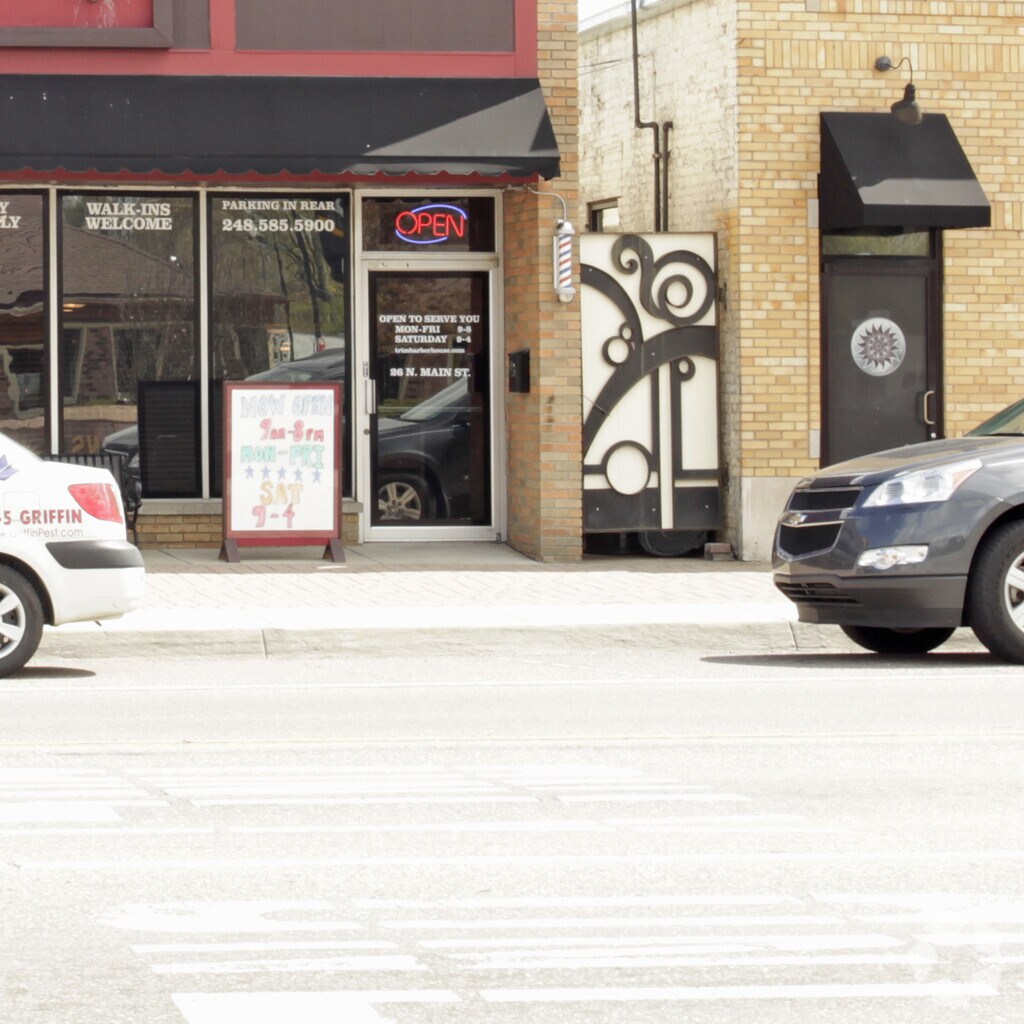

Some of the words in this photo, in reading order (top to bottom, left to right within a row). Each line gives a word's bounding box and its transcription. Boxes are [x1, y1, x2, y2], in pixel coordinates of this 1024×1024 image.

[86, 202, 171, 216] WALK-INS
[222, 200, 280, 211] PARKING
[282, 201, 298, 211] IN
[300, 201, 336, 211] REAR
[85, 217, 173, 231] WELCOME
[222, 219, 335, 232] 248.585.5900
[395, 211, 465, 237] OPEN
[379, 315, 407, 323] OPEN
[408, 315, 423, 323] TO
[424, 315, 457, 323] SERVE
[459, 315, 480, 323] YOU
[395, 325, 441, 333] MON-FRI
[395, 335, 448, 343] SATURDAY
[456, 335, 471, 343] 9-4
[389, 367, 404, 376] 26
[405, 368, 417, 376] N.
[420, 368, 452, 376] MAIN
[454, 368, 471, 377] ST.
[240, 394, 286, 418] NOW
[292, 394, 333, 417] OPEN
[259, 480, 304, 506] SAT
[19, 509, 83, 525] GRIFFIN
